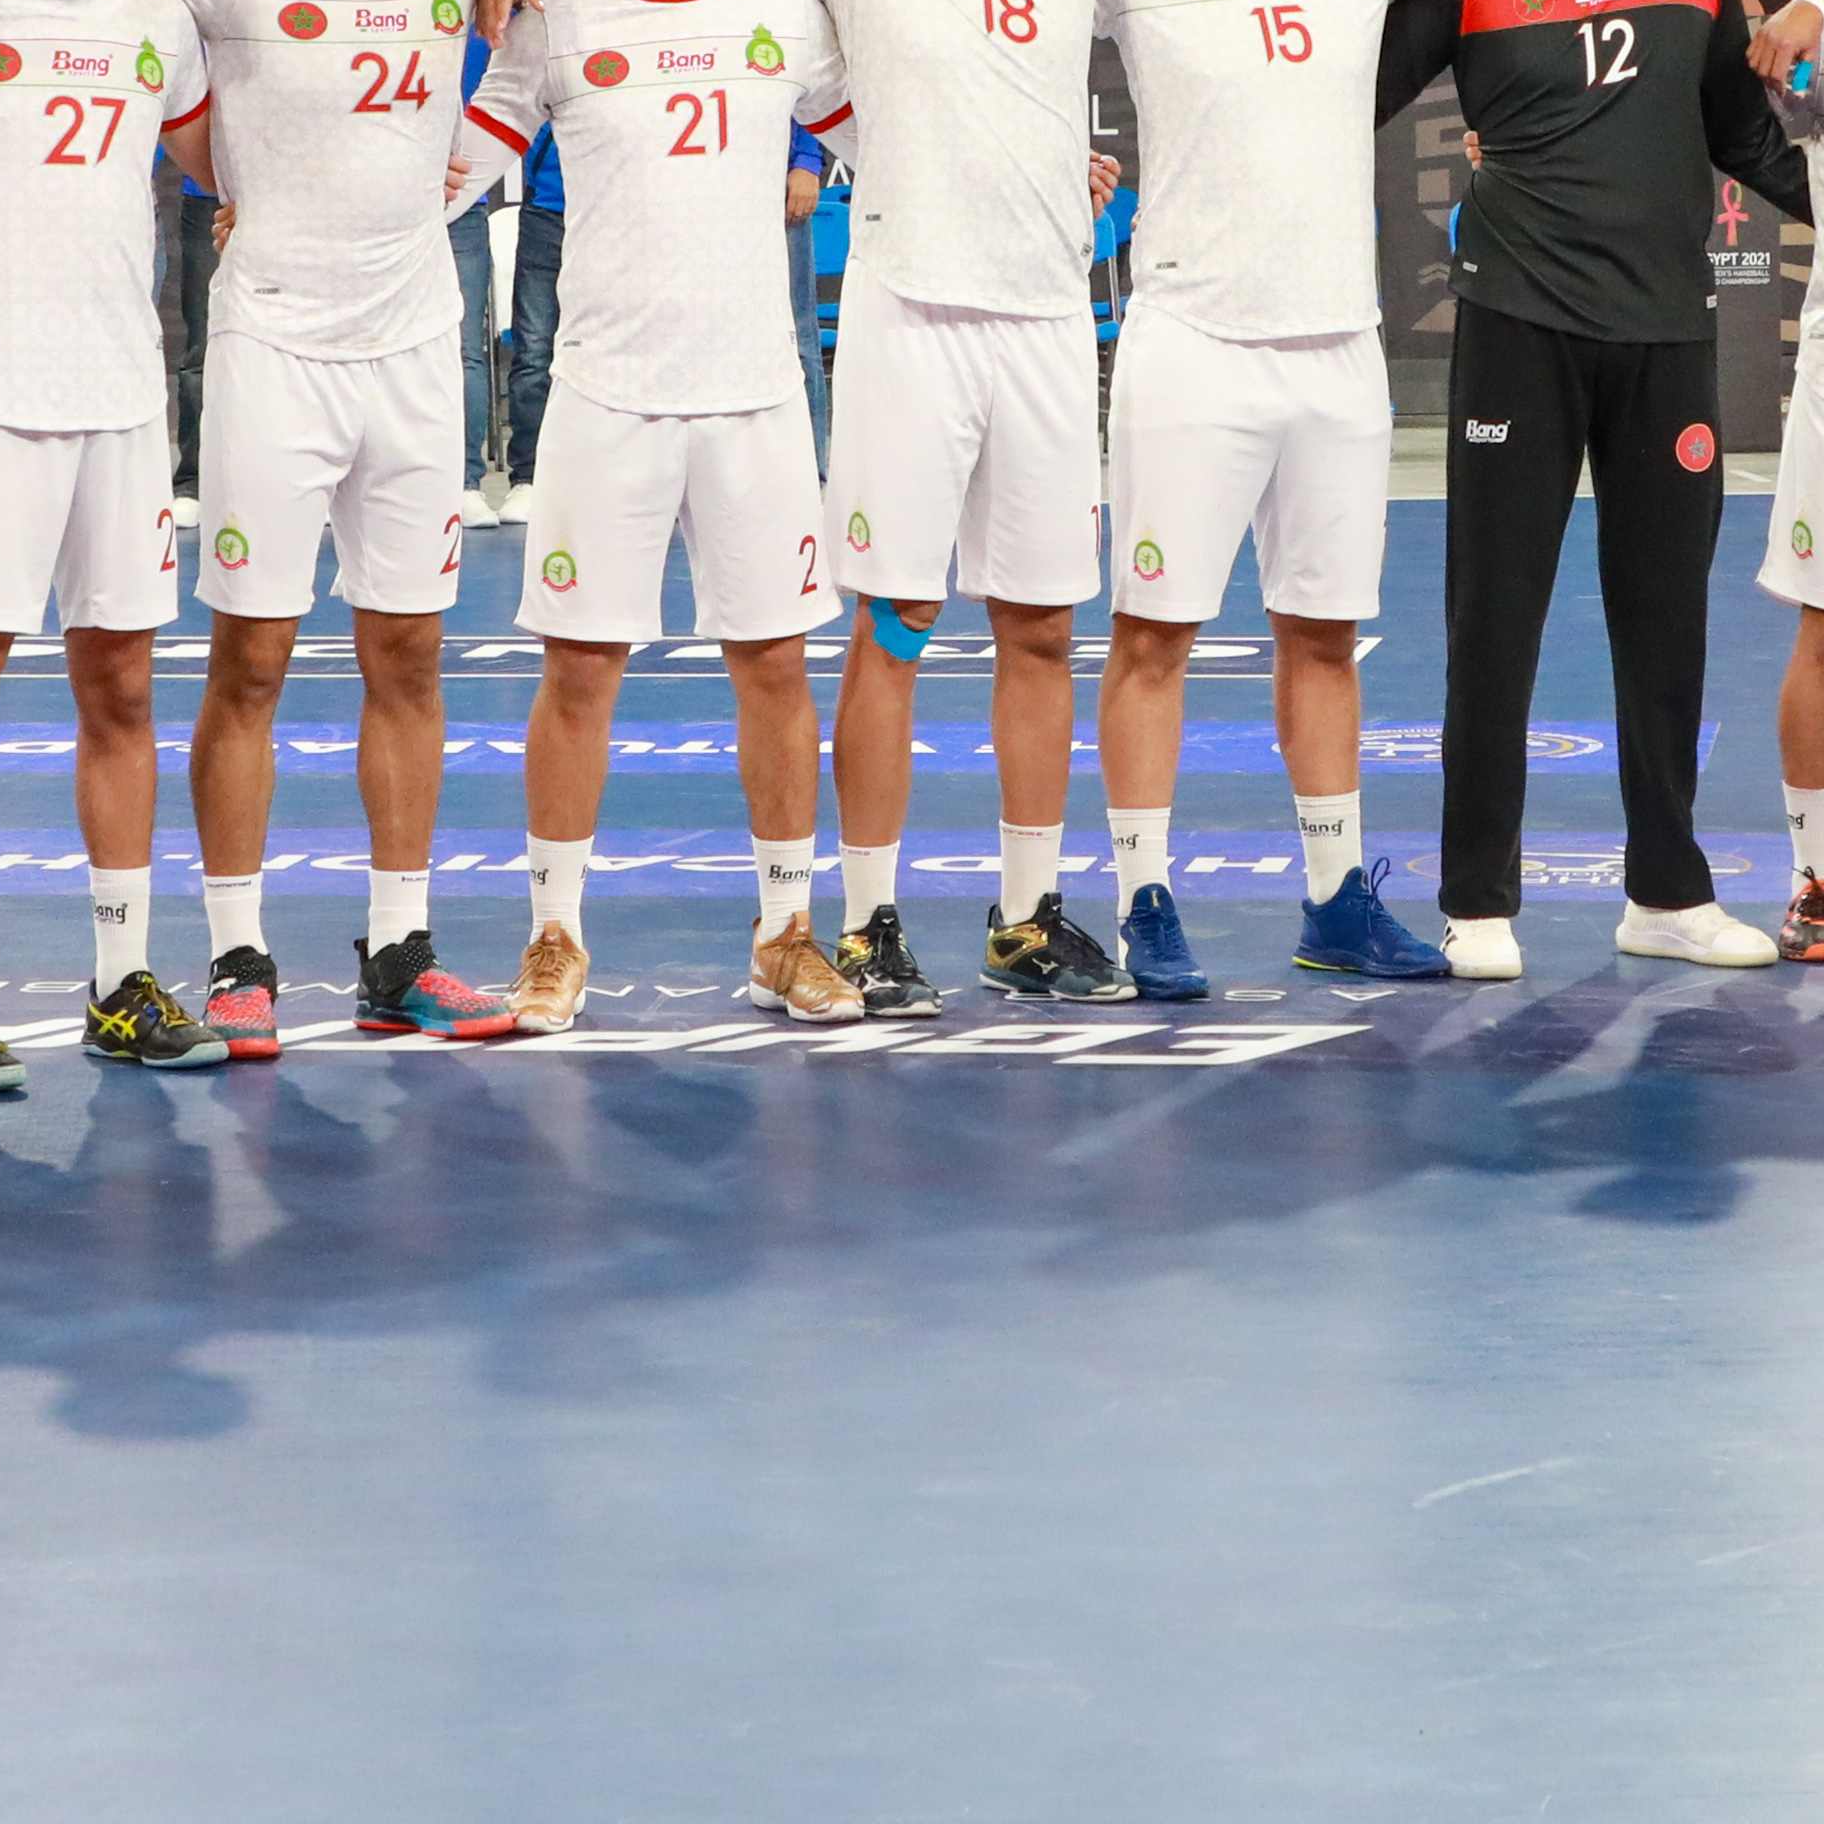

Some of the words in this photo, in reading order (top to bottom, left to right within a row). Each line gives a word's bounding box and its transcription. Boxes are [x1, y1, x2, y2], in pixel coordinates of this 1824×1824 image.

[355, 9, 404, 32] Bang
[1251, 3, 1313, 64] 15
[51, 49, 107, 77] Bang
[350, 49, 433, 114] 24
[657, 50, 714, 70] Bang
[1578, 19, 1638, 86] 12
[42, 95, 129, 167] 27
[666, 88, 729, 157] 21
[1741, 251, 1771, 266] 2021
